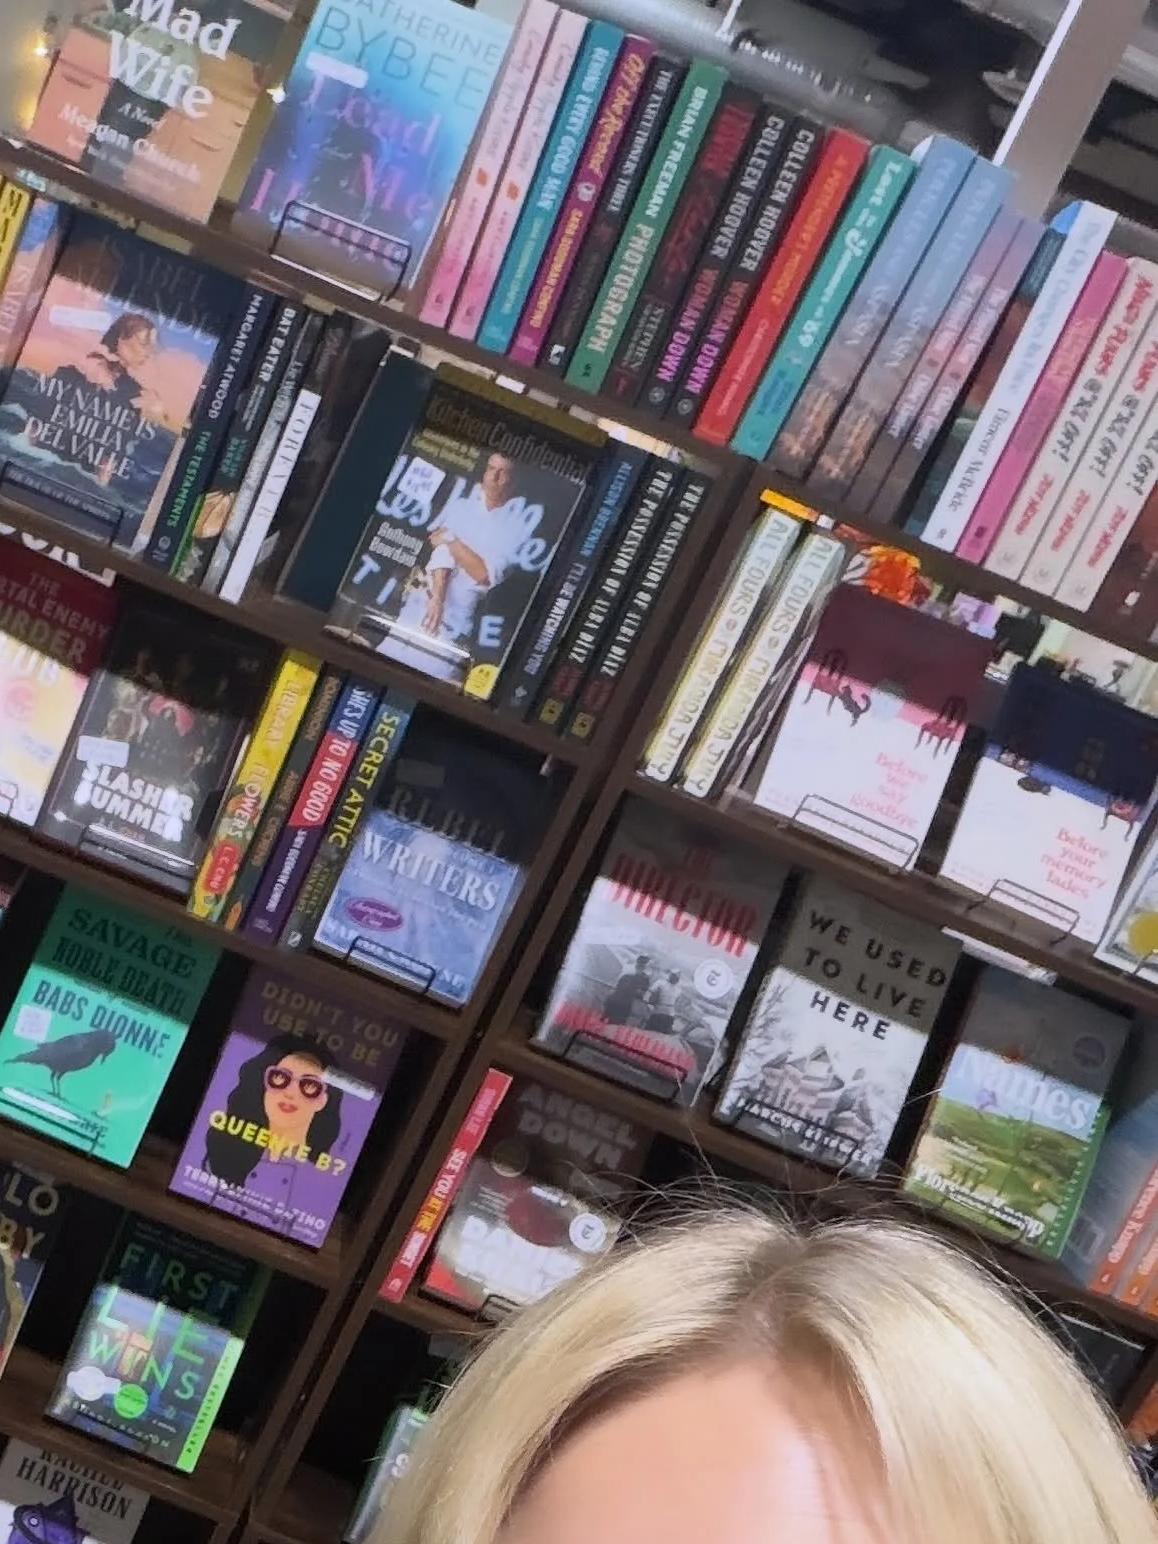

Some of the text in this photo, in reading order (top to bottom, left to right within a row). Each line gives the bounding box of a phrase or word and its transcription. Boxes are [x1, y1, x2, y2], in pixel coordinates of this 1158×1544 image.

[109, 30, 213, 119] Wife
[315, 7, 490, 111] BYBEE
[770, 129, 815, 204] COLLEEN
[588, 86, 708, 352] BRIAN FREEMAN PHOTOGRAPH
[657, 115, 785, 382] COLLEEN HOOVER WOMAN DOWN
[740, 206, 781, 272] HOOVER
[231, 294, 263, 363] MARGARET
[259, 308, 296, 381] BAT EATER
[709, 281, 749, 343] WOMAN
[208, 366, 238, 419] ATWOOD
[685, 344, 720, 395] DOWN
[34, 373, 156, 441] MY NAME IS
[50, 404, 123, 451] EMILIA
[24, 417, 136, 479] DEL VALLE
[196, 431, 212, 453] THE
[168, 454, 203, 527] TESTAMENTS
[602, 470, 673, 597] THE POSSESSION OF
[632, 483, 705, 611] THE POSSESSION OF
[730, 518, 790, 622] ALL FOURS
[772, 539, 834, 642] ALL FOURS
[345, 686, 372, 725] SHE'S
[318, 758, 343, 781] NO
[327, 713, 400, 849] SECRET ATTIC
[328, 739, 351, 758] TO
[301, 781, 333, 823] GOOD
[362, 832, 500, 911] WRITERS
[68, 908, 196, 978] SAVAGE
[808, 910, 947, 988] WE USED
[261, 980, 399, 1047] DIDN'T YOU
[804, 948, 923, 1019] TO LIVE
[810, 991, 890, 1040] HERE
[33, 980, 171, 1059] BABS DIONNE
[263, 1008, 382, 1066] USE TO BE
[957, 1049, 1091, 1131] Names
[209, 1109, 347, 1177] QUEENIE B?
[437, 1173, 455, 1200] YOU
[121, 1243, 241, 1310] FIRST
[96, 1285, 219, 1366] LIE
[88, 1331, 201, 1400] WINS
[16, 1456, 134, 1521] HARRISON
